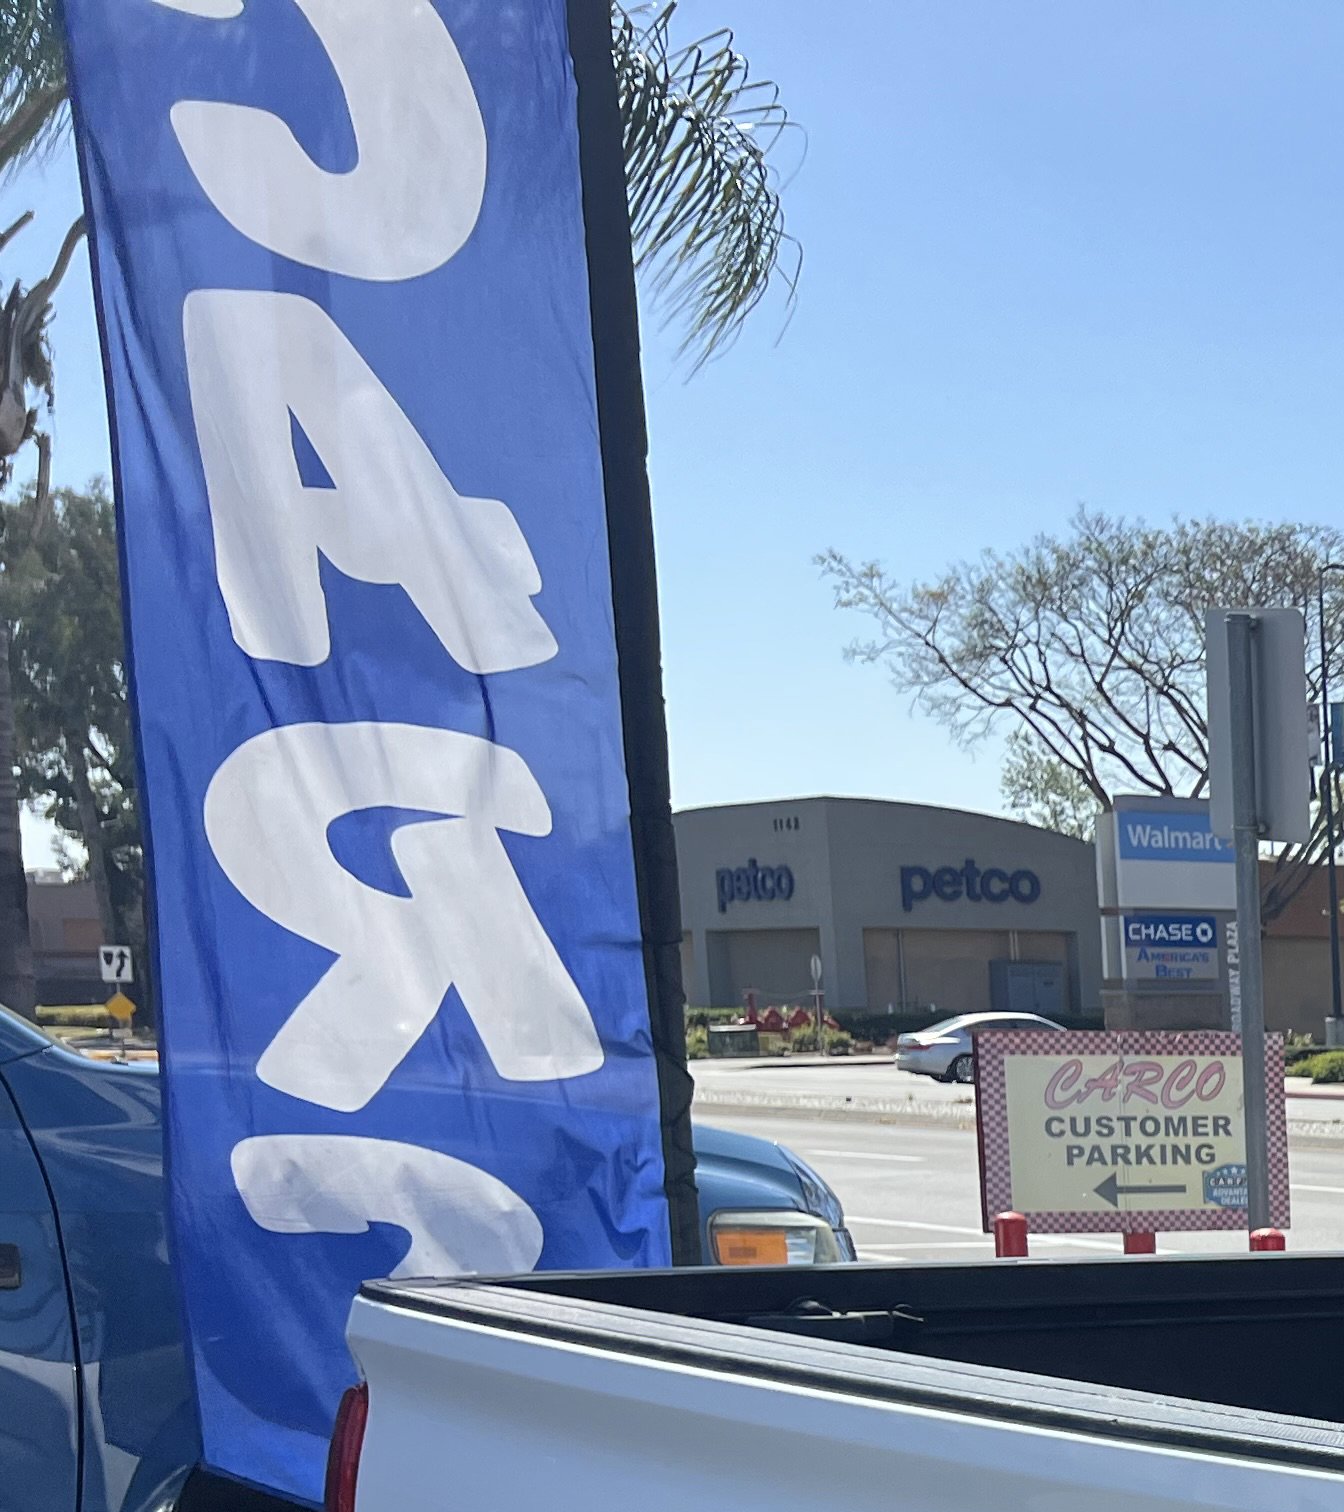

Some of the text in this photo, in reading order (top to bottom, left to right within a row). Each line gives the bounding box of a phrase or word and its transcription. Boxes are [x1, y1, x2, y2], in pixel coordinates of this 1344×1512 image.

[1127, 823, 1222, 850] Walmart
[716, 857, 794, 914] petco
[900, 857, 1041, 912] petco
[1128, 923, 1193, 941] CHASE
[1044, 1058, 1226, 1110] CARCO
[1045, 1115, 1232, 1138] CUSTOMER
[1066, 1143, 1216, 1166] PARKING
[1210, 1177, 1247, 1186] CARF
